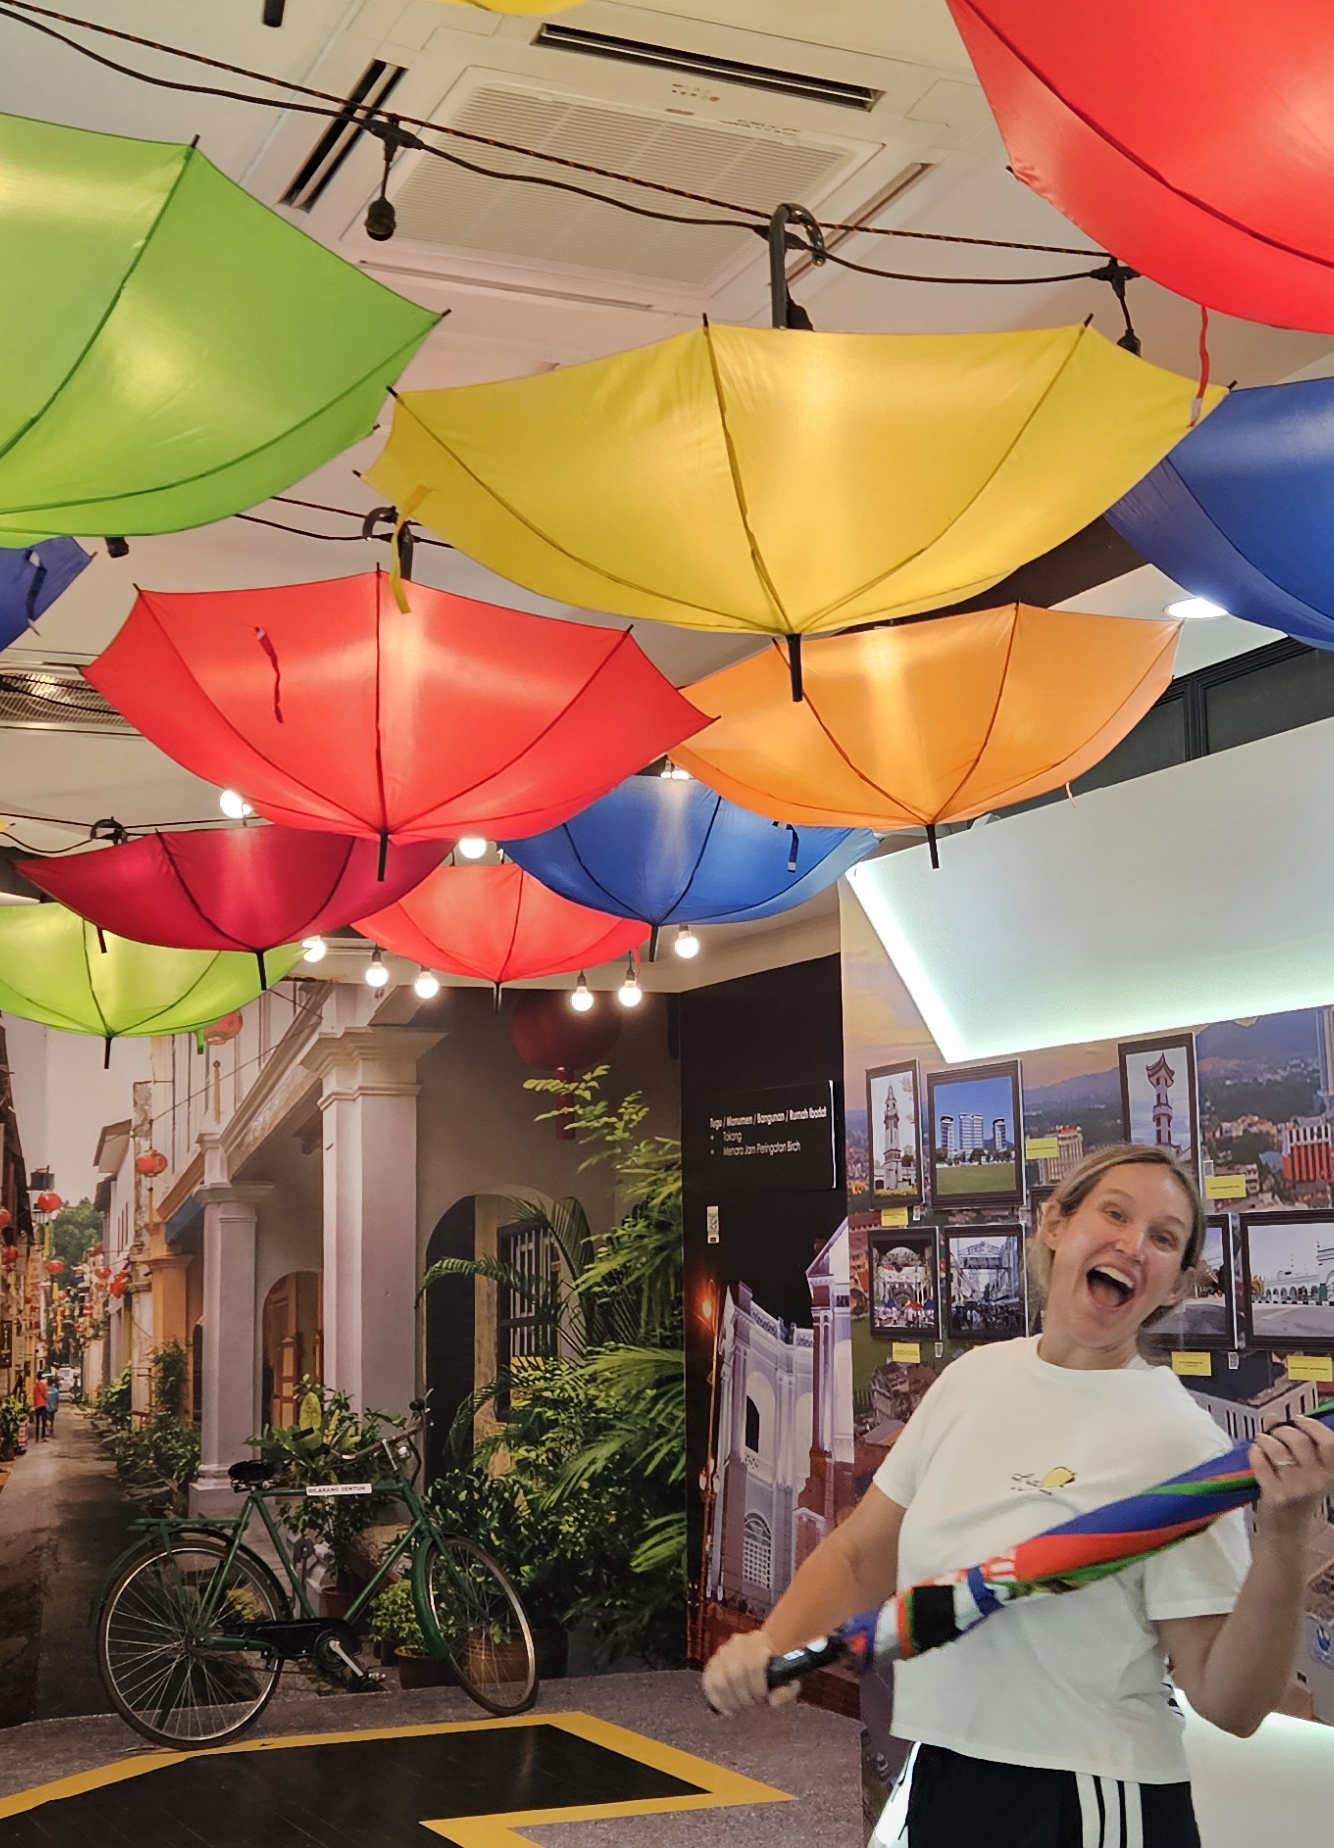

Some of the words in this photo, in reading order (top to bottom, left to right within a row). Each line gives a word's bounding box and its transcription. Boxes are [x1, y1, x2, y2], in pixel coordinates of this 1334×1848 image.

[757, 1112, 785, 1126] Bangunan
[789, 1108, 808, 1120] Rumah
[809, 1106, 827, 1119] Ibadat
[723, 1146, 744, 1156] Menara
[745, 1144, 756, 1155] Jam
[757, 1142, 786, 1156] Peringatan
[787, 1140, 801, 1152] Birch
